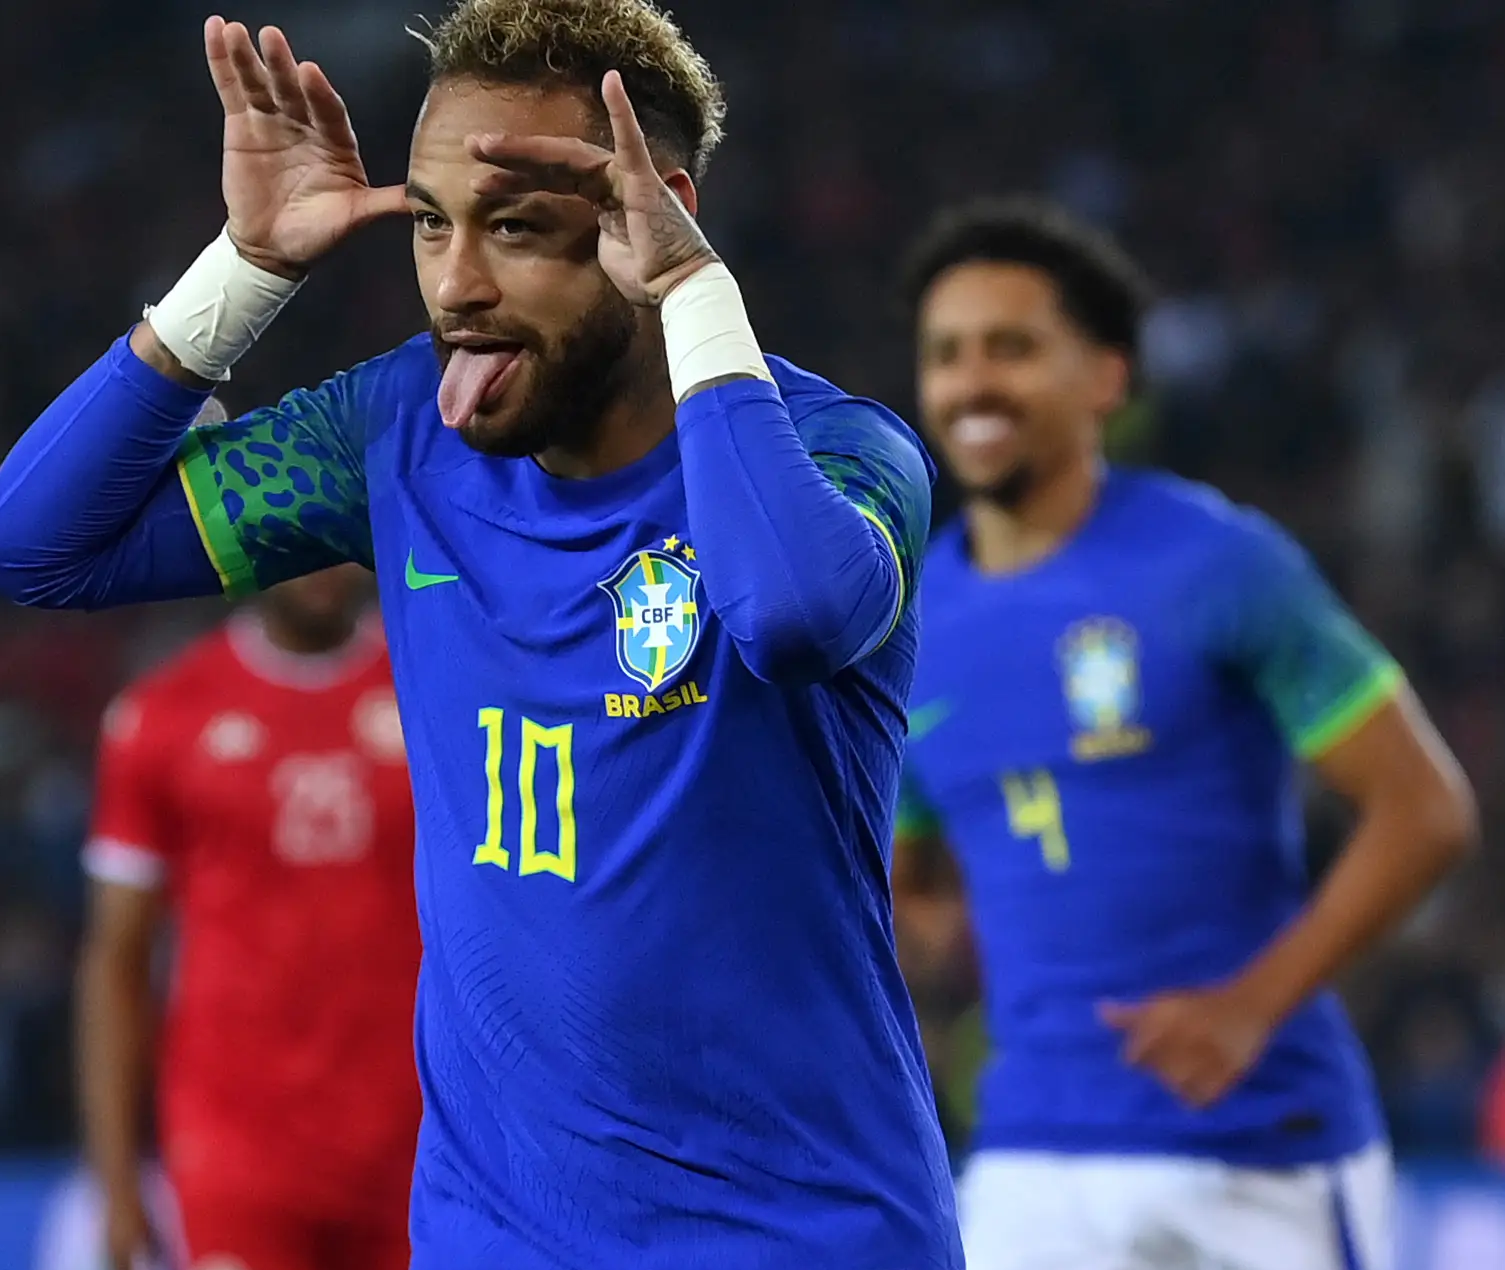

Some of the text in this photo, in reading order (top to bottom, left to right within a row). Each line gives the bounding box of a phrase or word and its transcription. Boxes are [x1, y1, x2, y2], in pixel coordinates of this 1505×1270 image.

[641, 606, 674, 624] CBF
[604, 681, 709, 718] BRASIL
[471, 706, 577, 883] 10
[1001, 767, 1071, 872] 4
